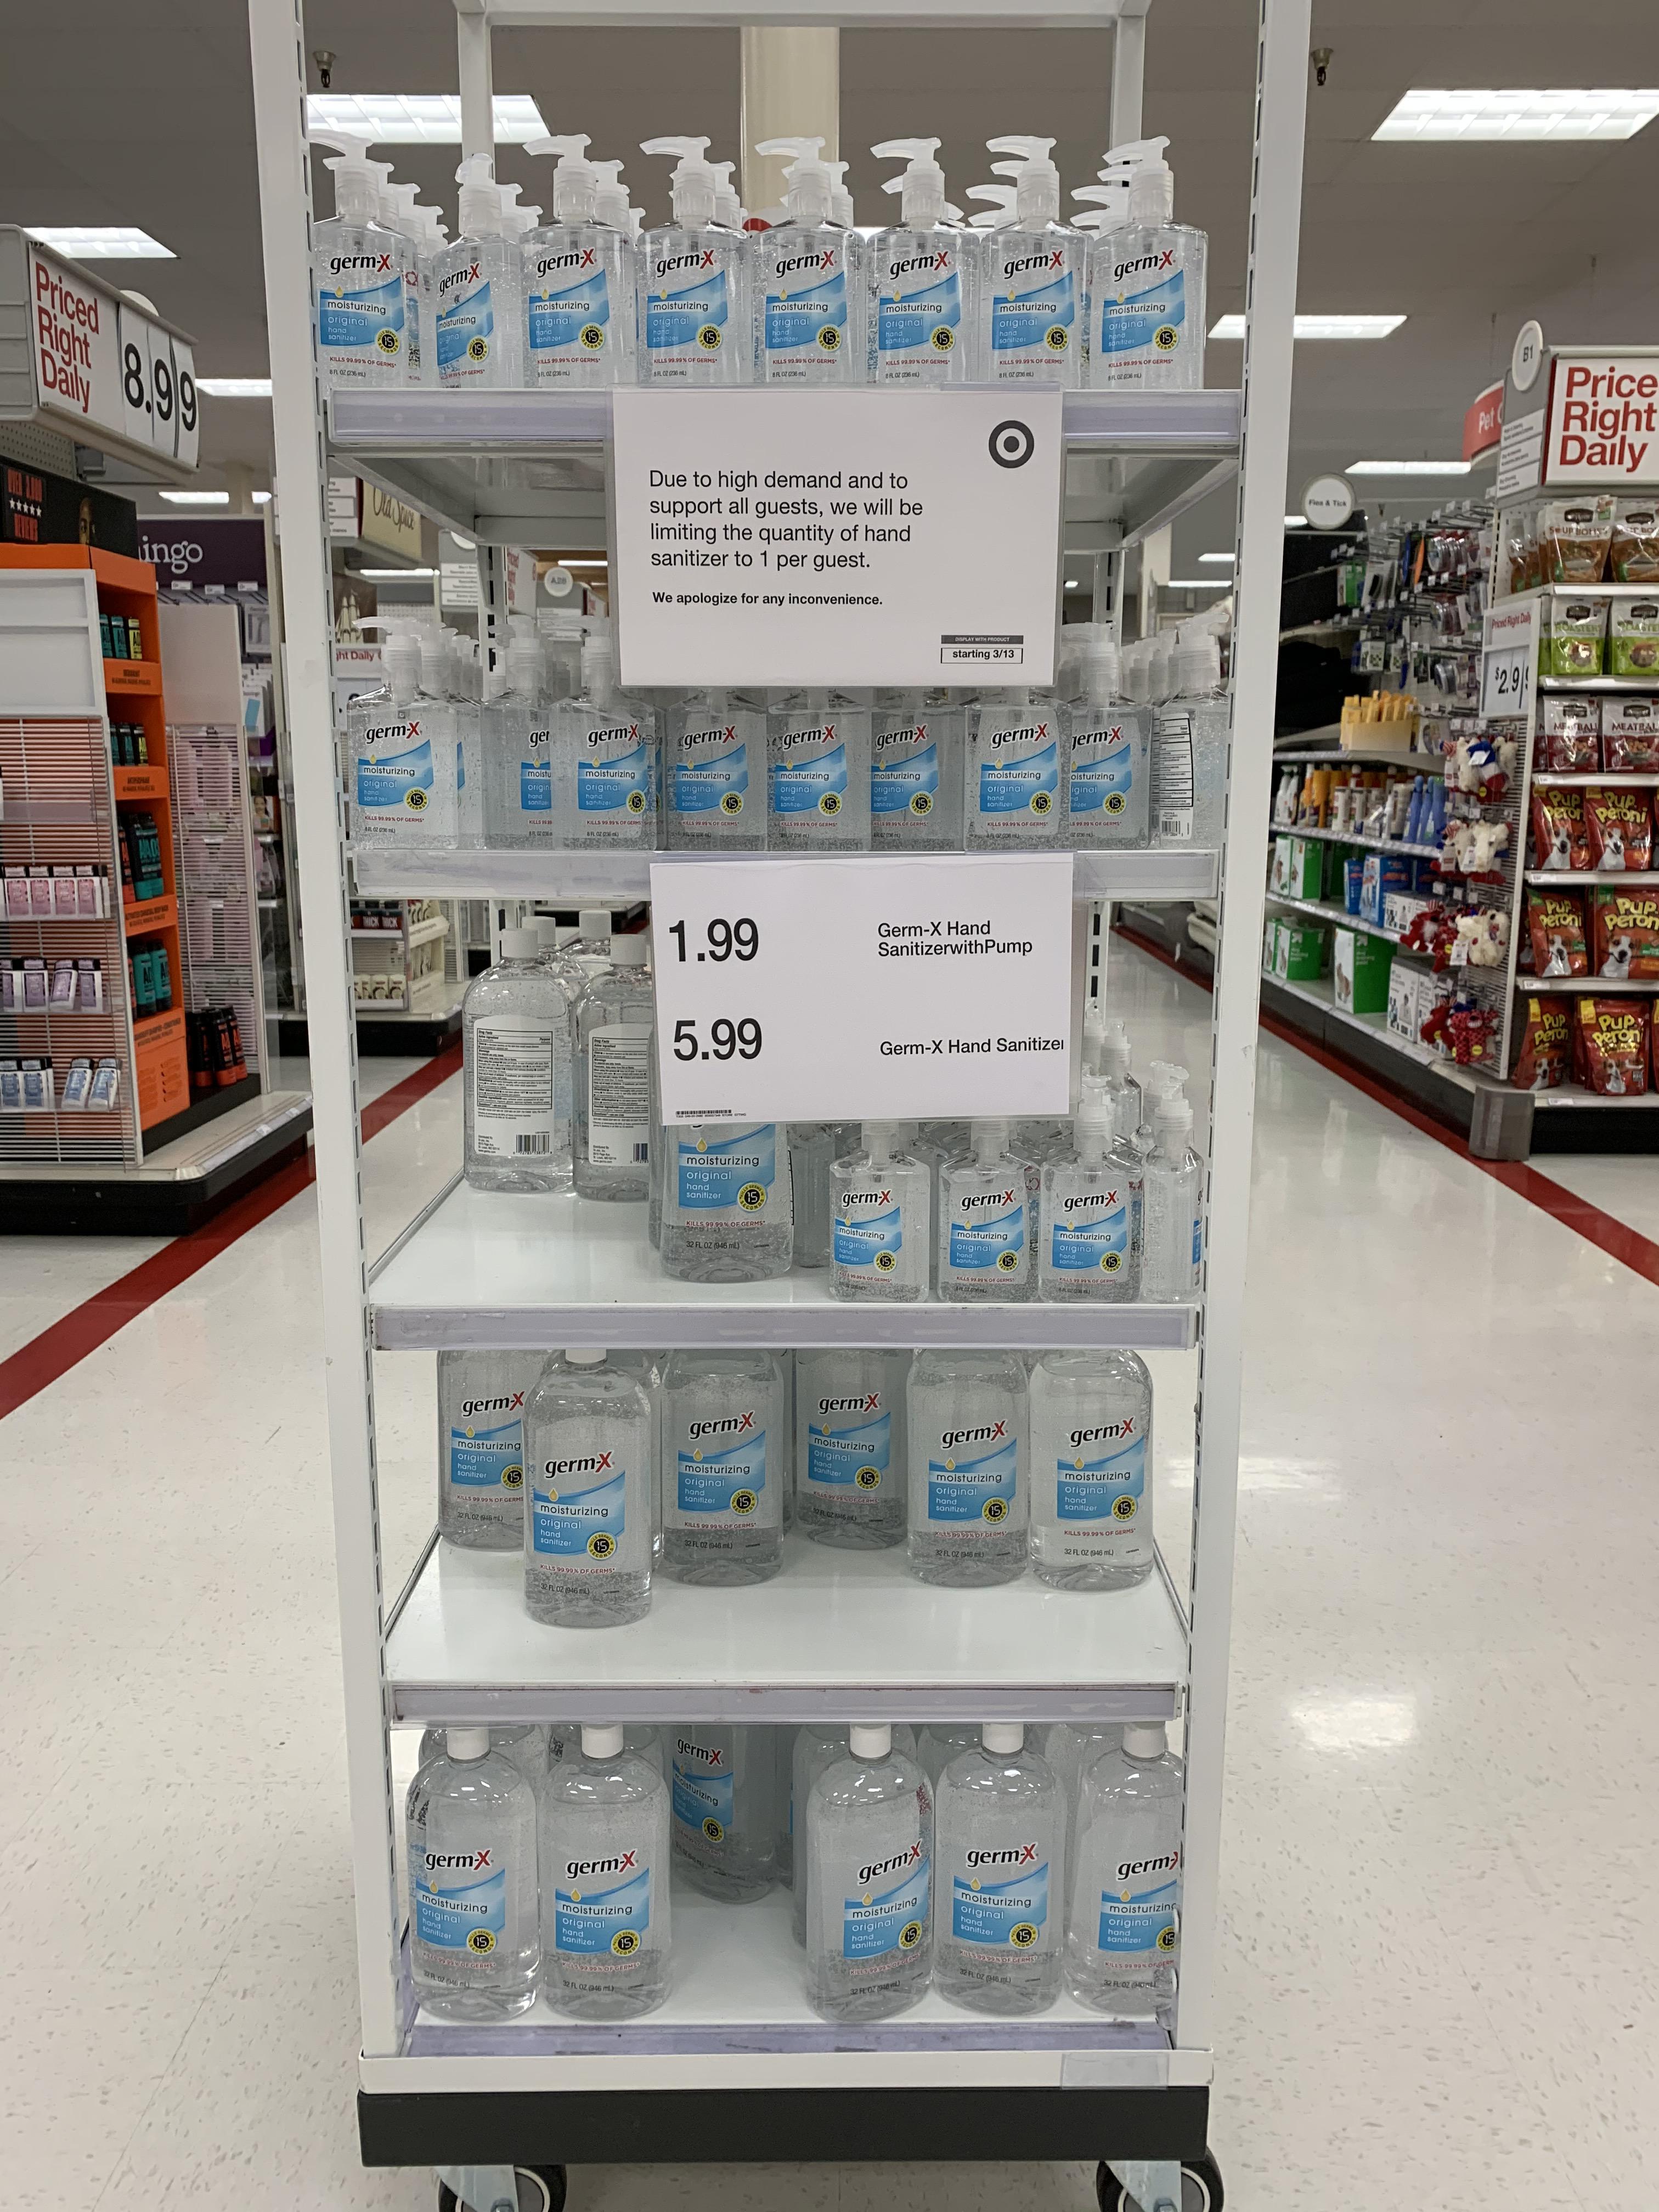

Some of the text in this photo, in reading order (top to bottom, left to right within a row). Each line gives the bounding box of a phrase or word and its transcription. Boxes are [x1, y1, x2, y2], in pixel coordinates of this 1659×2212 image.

[36, 261, 99, 335] Priced
[328, 300, 386, 315] moisturizing
[535, 301, 589, 313] moisturizing
[653, 302, 708, 312] moisturizing
[772, 302, 828, 313] moisturizing
[886, 303, 942, 313] moisturizing
[1000, 302, 1056, 313] moisturizing
[1110, 302, 1165, 317] moisturizing
[38, 304, 92, 369] Right
[41, 347, 90, 414] Daily
[1566, 366, 1659, 398] Price
[124, 343, 197, 432] 8.99
[1562, 400, 1657, 439] Right
[1559, 435, 1649, 473] Daily
[650, 470, 907, 492] Due to high demand and to
[651, 498, 922, 518] support all guests, we will be
[651, 523, 910, 545] limiting the quantity of hand
[139, 535, 202, 574] ingo
[652, 550, 870, 572] sanitizer to 1 per guest.
[653, 592, 882, 606] We apologize for any inconvenience.
[953, 650, 1014, 659] starting 3/13
[364, 766, 415, 777] moisturizing
[585, 769, 635, 780] moisturizing
[681, 771, 731, 782] moisturizing
[780, 771, 830, 782] moisturizing
[874, 771, 920, 781] moisturizing
[988, 770, 1041, 780] moisturizing
[1071, 772, 1115, 781] oisturizing
[1605, 913, 1659, 930] Peron
[878, 921, 990, 937] Germ-X Hand
[669, 918, 758, 962] 1.99
[878, 939, 1032, 956] SanitizerwithPump
[674, 1018, 761, 1060] 5.99
[881, 1040, 943, 1055] Germ-X
[949, 1039, 990, 1053] Hand
[686, 1155, 760, 1167] moisturizing
[686, 1171, 732, 1181] original
[747, 1192, 758, 1203] 15
[839, 1227, 884, 1240] moisturizing
[957, 1232, 1008, 1241] moisturizing
[1060, 1233, 1111, 1242] moisturizing
[458, 1441, 522, 1451] moisturizing
[814, 1437, 874, 1452] moisturizing
[685, 1464, 750, 1475] moisturizing
[936, 1473, 1002, 1483] moisturizing
[1065, 1471, 1131, 1482] moisturizing
[685, 1478, 724, 1488] original
[1065, 1484, 1106, 1494] original
[936, 1486, 977, 1497] original
[540, 1505, 608, 1517] moisturizing
[540, 1519, 581, 1529] original
[674, 1772, 718, 1807] moisturizing
[422, 1894, 488, 1914] moisturizing
[961, 1892, 1031, 1908] moisturizing
[562, 1903, 632, 1916] moisturizing
[852, 1897, 917, 1918] moisturizing
[562, 1917, 605, 1929] original
